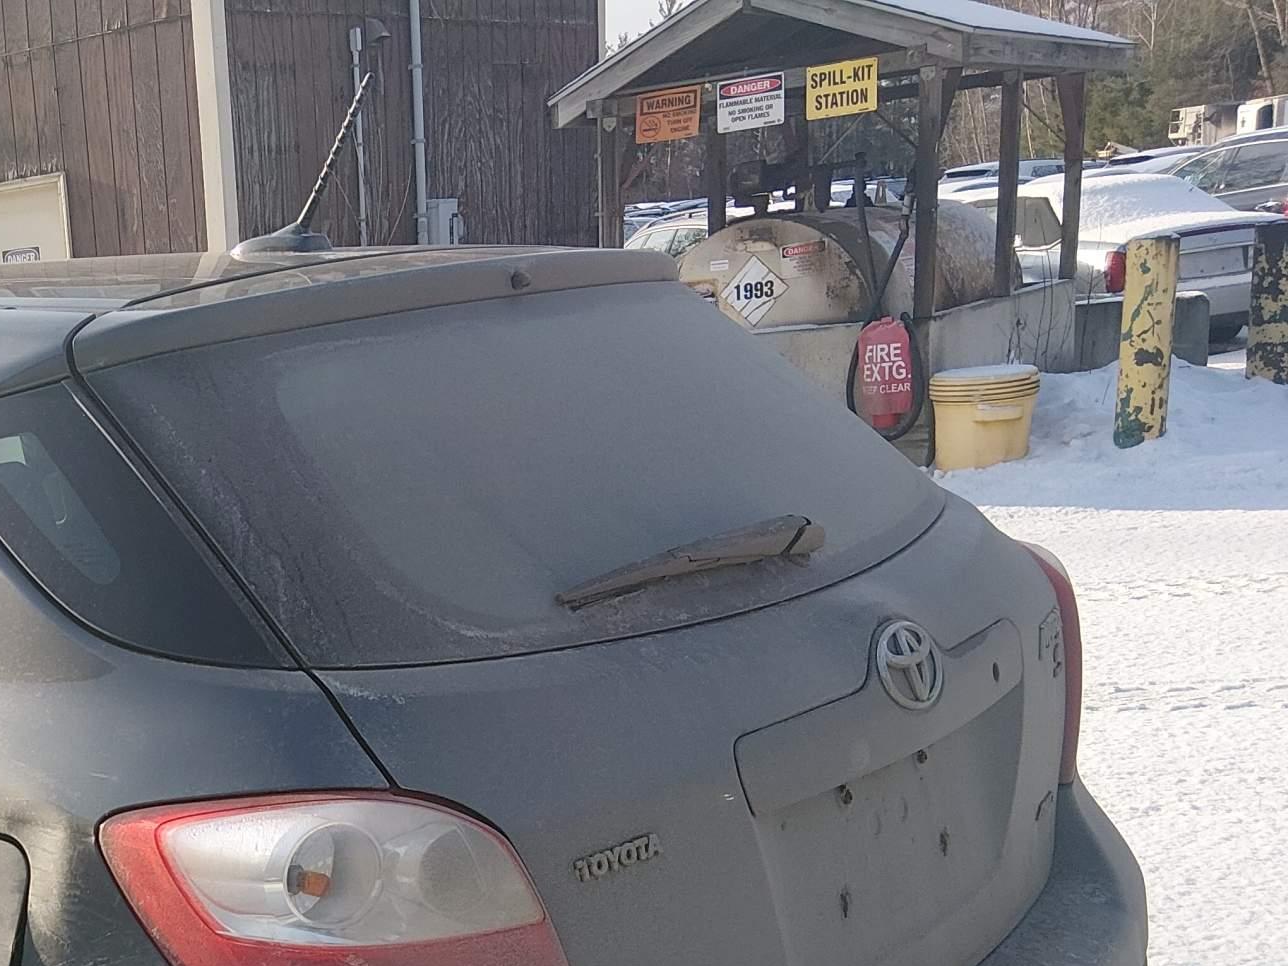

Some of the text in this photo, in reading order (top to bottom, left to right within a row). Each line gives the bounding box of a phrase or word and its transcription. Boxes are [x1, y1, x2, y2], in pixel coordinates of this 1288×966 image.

[810, 64, 874, 90] SPILL-KIT
[730, 80, 771, 95] DANGER
[645, 94, 691, 111] WARNING
[719, 97, 754, 109] FLAMMABLE
[815, 87, 868, 111] STATION
[731, 111, 770, 123] OPEN FLAMES
[737, 105, 764, 115] SMOKING
[765, 103, 774, 111] OR
[734, 280, 775, 301] 1993
[865, 343, 902, 363] FIRE
[863, 361, 912, 382] EXTG.
[879, 382, 911, 394] CLEAR
